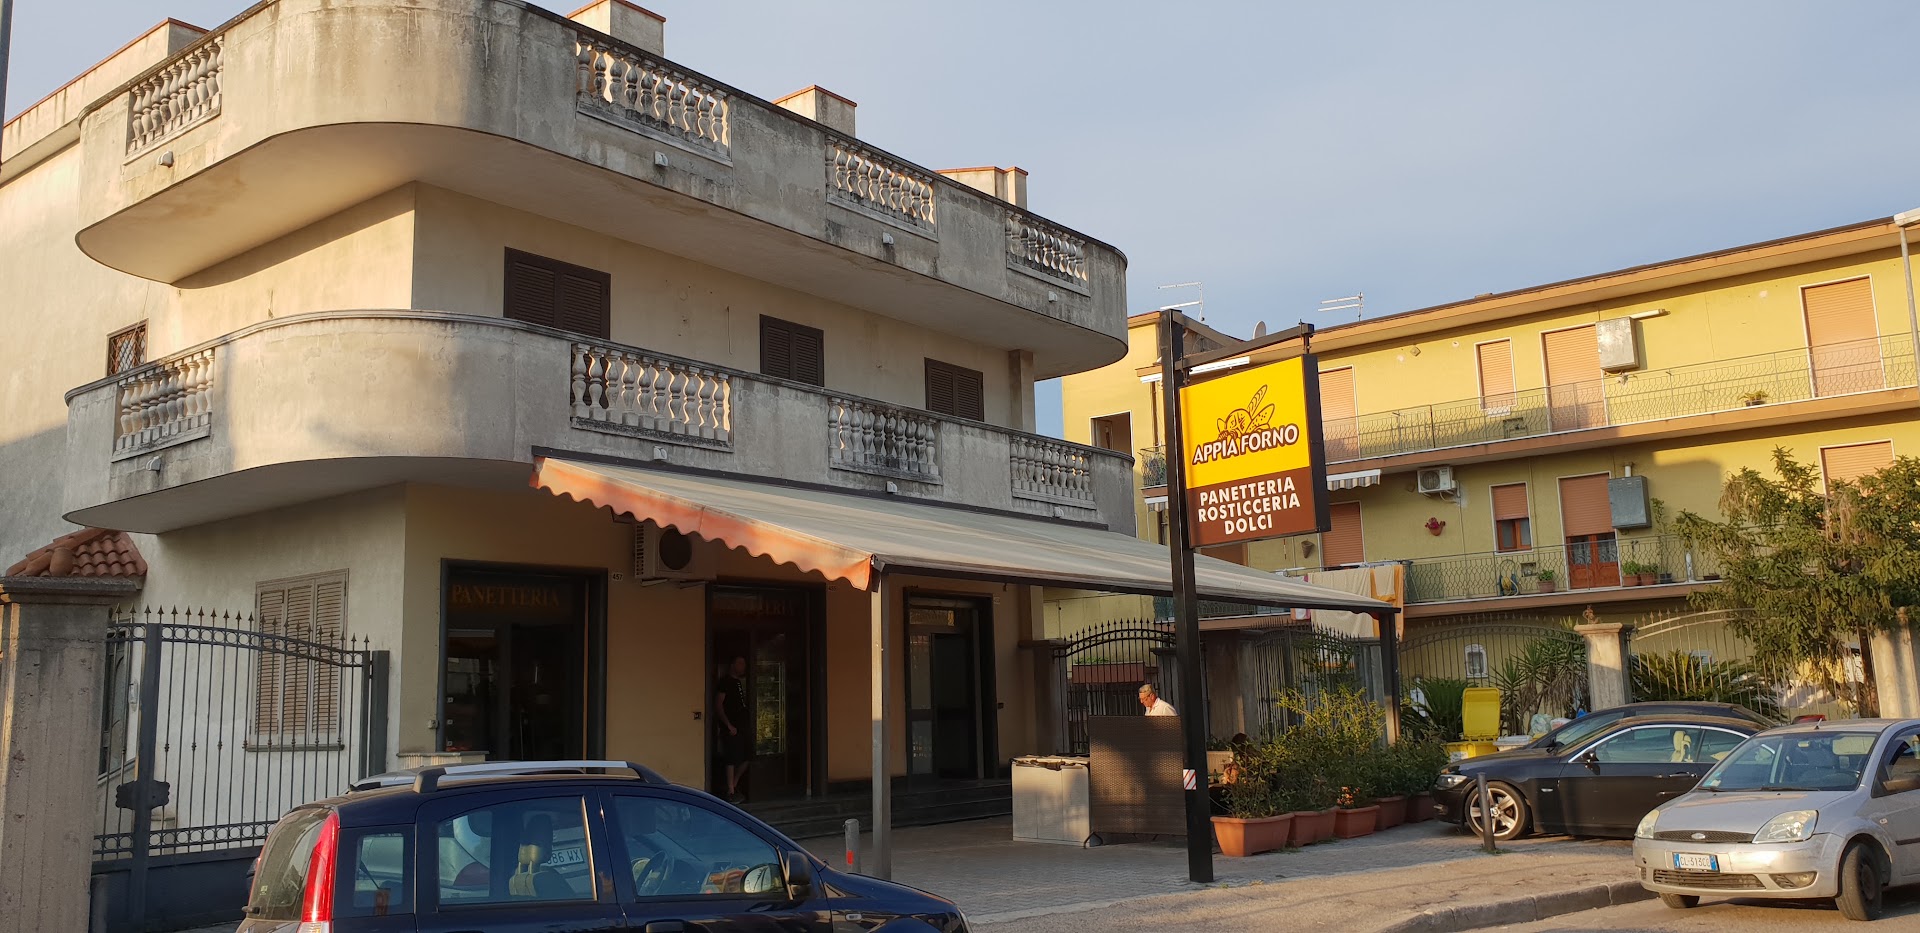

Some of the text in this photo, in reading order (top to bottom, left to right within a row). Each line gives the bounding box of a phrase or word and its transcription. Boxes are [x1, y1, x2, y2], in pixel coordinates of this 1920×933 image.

[1192, 423, 1299, 465] APPIA FORNO
[1200, 476, 1295, 507] PANETTERIA
[1198, 492, 1300, 523] ROSTICCERIA
[1224, 513, 1273, 535] DOLCI
[452, 584, 559, 606] PANETTERIA
